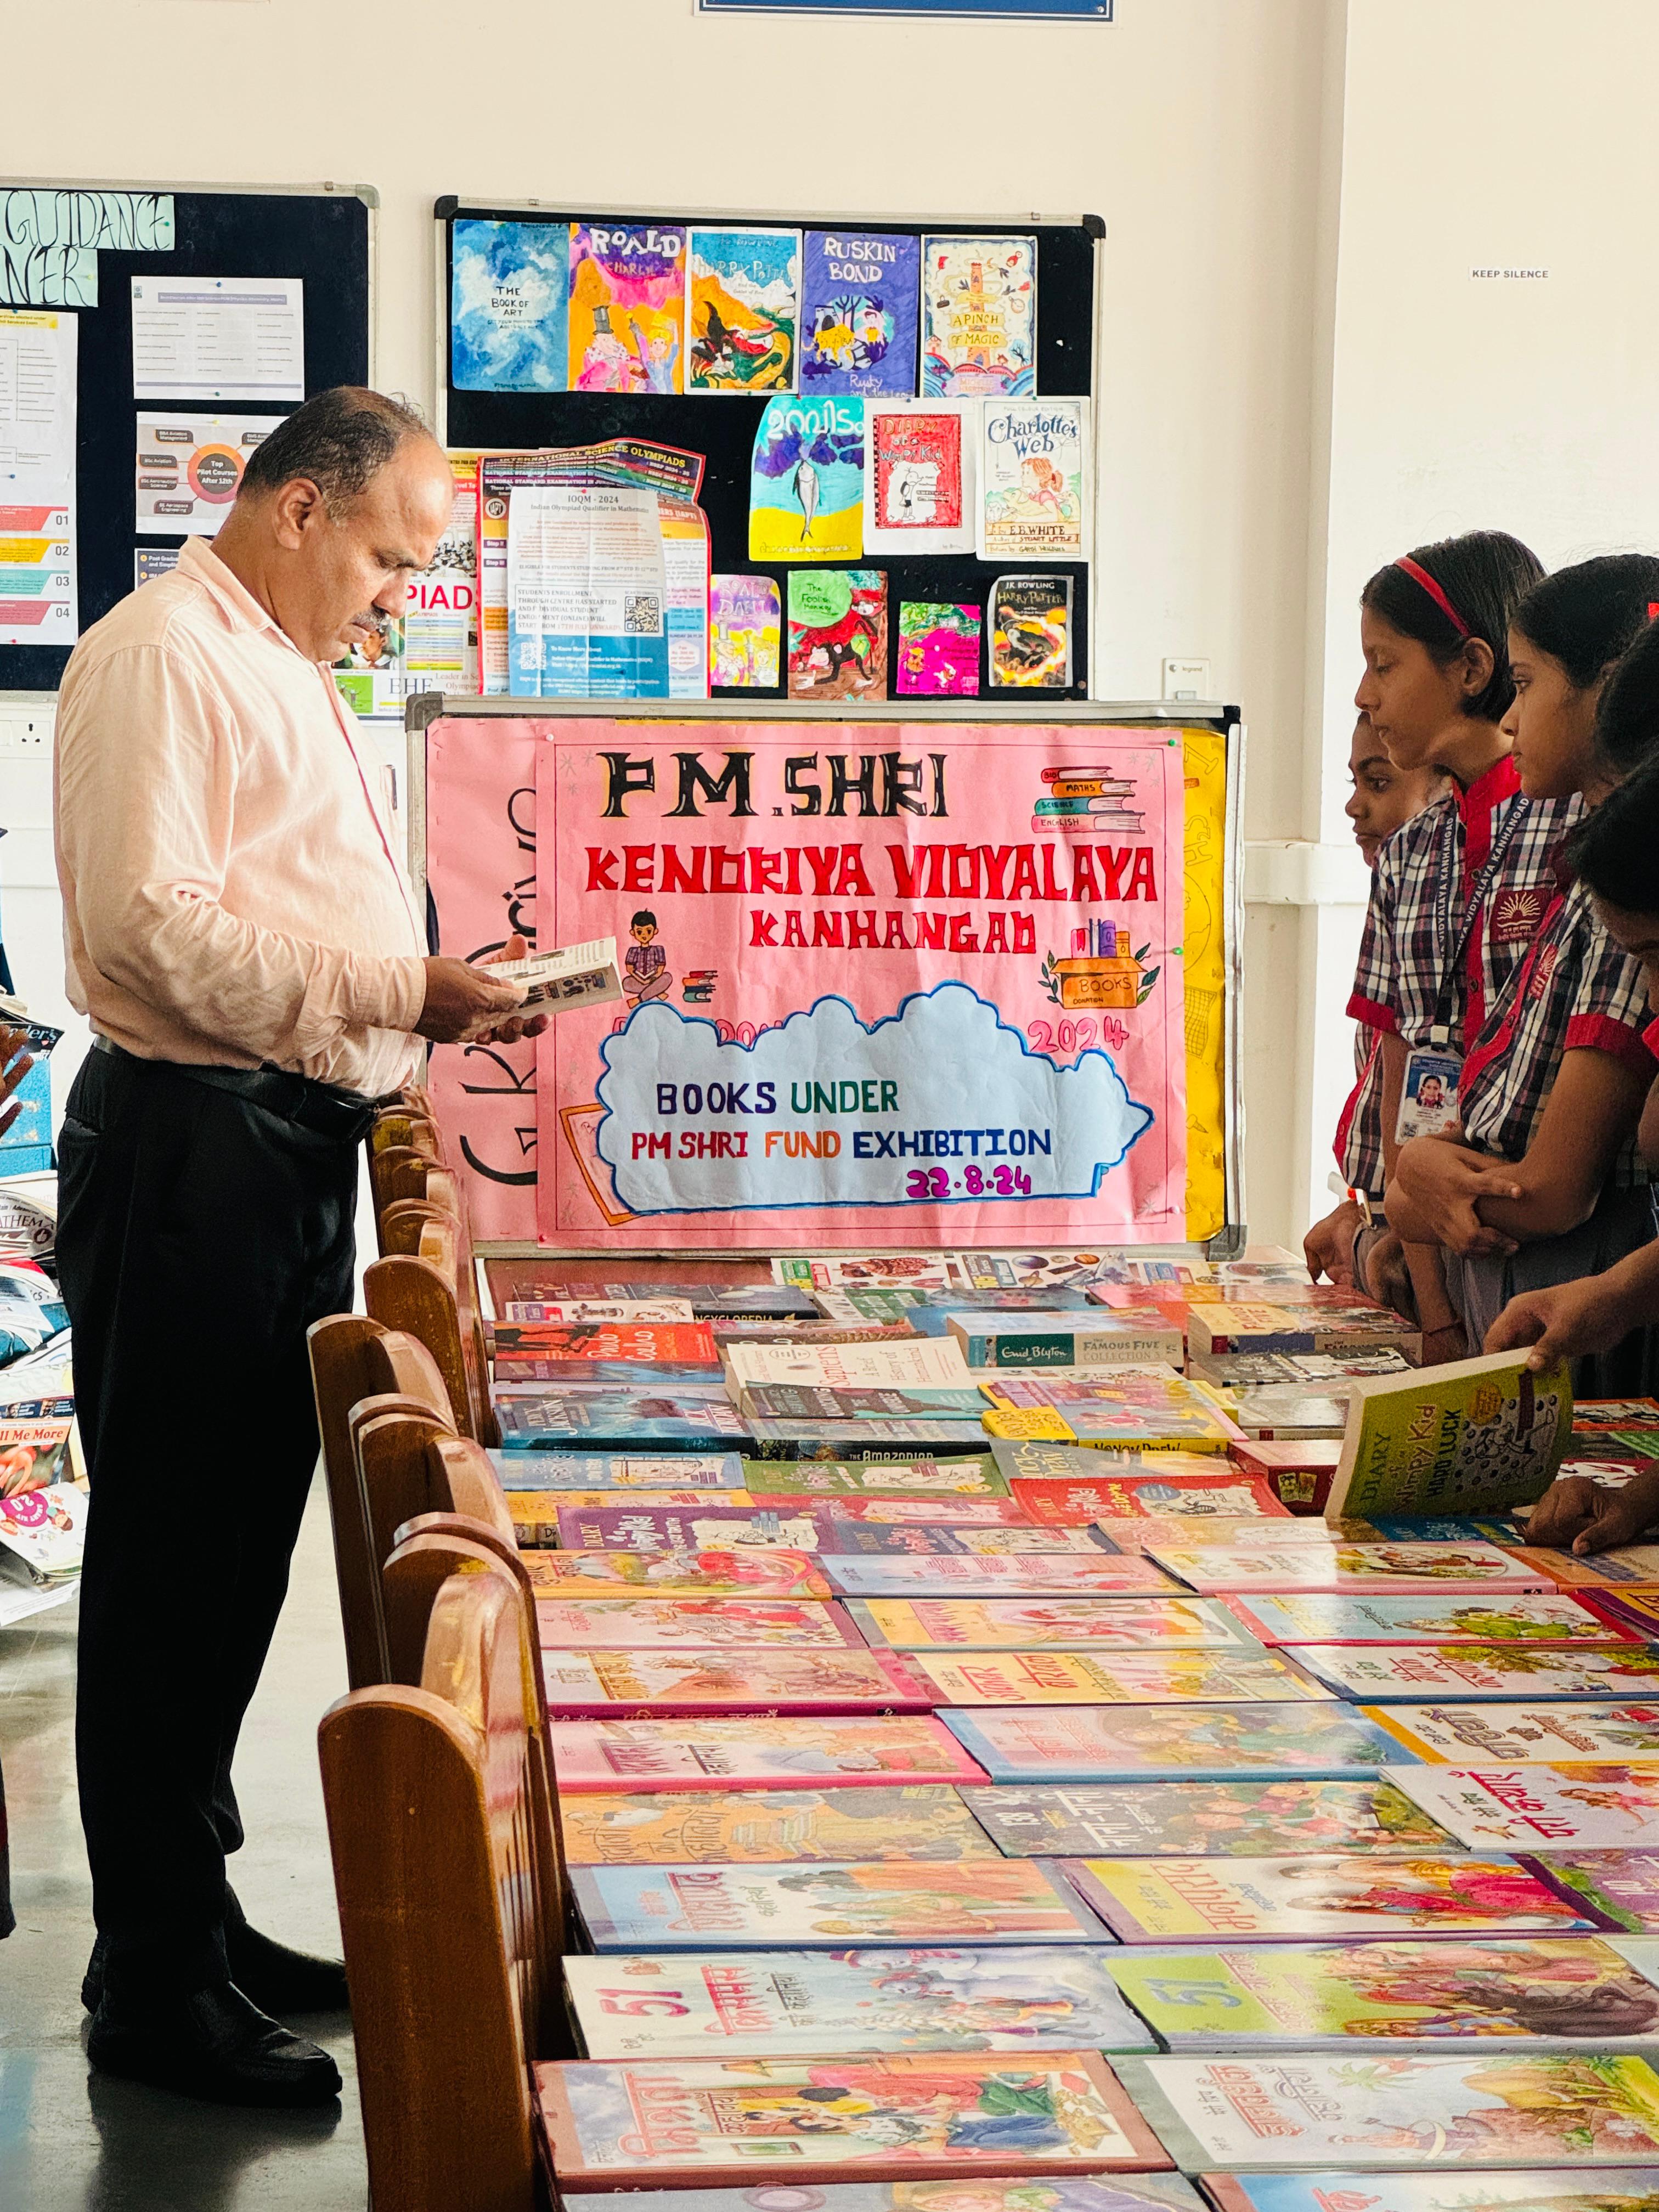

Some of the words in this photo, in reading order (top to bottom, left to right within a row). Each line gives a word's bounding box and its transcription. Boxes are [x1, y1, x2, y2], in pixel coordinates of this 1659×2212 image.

[5, 190, 171, 250] GUIDANCE
[590, 228, 681, 257] ROALD
[823, 237, 896, 262] RUSKIN
[0, 245, 88, 307] NER
[829, 262, 883, 283] BOND
[1504, 270, 1549, 278] SILENCE
[496, 286, 520, 296] THE
[492, 298, 514, 308] BOOK
[515, 298, 529, 308] OF
[503, 309, 523, 317] ART
[953, 317, 961, 326] A
[964, 314, 998, 325] PINCH
[964, 334, 1000, 345] MAGIC
[850, 375, 883, 390] Rusty
[884, 419, 936, 435] DIARY
[988, 413, 1079, 443] Charlotte's
[499, 450, 584, 462] INTERNATIONAL
[585, 444, 629, 456] SCIENCE
[630, 447, 686, 467] OLYMPIADS
[921, 443, 942, 460] Kid
[1012, 433, 1054, 460] Web
[211, 460, 224, 468] Top
[568, 495, 591, 504] IOQM
[599, 495, 619, 504] 2024
[55, 515, 69, 526] 01
[55, 546, 70, 556] 02
[55, 576, 70, 586] 03
[720, 582, 768, 598] ROALD
[807, 583, 822, 592] The
[719, 599, 767, 616] DAHL
[804, 603, 832, 612] Monkey
[997, 591, 1028, 604] HARRY
[1028, 591, 1064, 604] POTTER
[56, 607, 70, 618] 04
[1066, 783, 1096, 792] MATHS
[1041, 800, 1074, 809] SCIENCE
[1040, 817, 1080, 827] ENGLISH
[1491, 797, 1530, 861] KANHANGAD
[1441, 817, 1454, 881] KANHANGAD
[584, 843, 876, 897] KENDRIYA
[884, 843, 1159, 902] VIDYALAYA
[1466, 864, 1494, 923] VIDYALAYA
[1436, 882, 1448, 944] VIDYALAYA
[748, 909, 1037, 955] KANHANGAD
[1079, 977, 1132, 993] BOOKS
[1073, 997, 1104, 1005] DONATION
[1028, 1016, 1130, 1054] 2024
[657, 1081, 776, 1115] BOOKS
[791, 1079, 900, 1114] UNDER
[631, 1131, 673, 1159] PM
[676, 1130, 749, 1159] SHRI
[764, 1130, 841, 1159] FUND
[853, 1127, 1052, 1159] EXHIBITION
[586, 1333, 620, 1358] Paulo
[625, 1330, 657, 1361] Coelho
[1002, 1346, 1029, 1361] Enid
[1031, 1346, 1067, 1364] Blyton
[1084, 1341, 1131, 1351] FAMOUS
[1133, 1340, 1160, 1350] FIVE
[815, 1346, 857, 1386] Sapiens
[856, 1357, 878, 1372] Brief
[887, 1360, 909, 1381] History
[904, 1347, 932, 1383] Humankind
[813, 1387, 845, 1416] UNLOCKING
[523, 1408, 546, 1426] PERCY
[543, 1399, 578, 1435] JACKSON
[685, 1409, 713, 1426] RICK
[12, 1429, 31, 1441] Me
[33, 1429, 64, 1440] More
[1438, 1408, 1463, 1457] LUCK
[1359, 1430, 1391, 1500] DIARY
[1033, 1497, 1062, 1517] DIARY
[618, 1515, 656, 1530] Kid
[665, 1516, 681, 1533] TRUTH
[579, 1522, 603, 1547] DIARY
[1011, 1653, 1079, 1688] बीरबल
[957, 1665, 1027, 1700] अकबर
[995, 1812, 1042, 1826] 138
[1507, 1815, 1580, 1839] परी
[1139, 1863, 1256, 1930] मनपसंद
[595, 1988, 691, 2017] 51
[703, 1963, 775, 2036] क्रिसमस
[1141, 1978, 1242, 2007] 51
[617, 2070, 708, 2158] मित्रता
[693, 2092, 748, 2134] कहानियाँ
